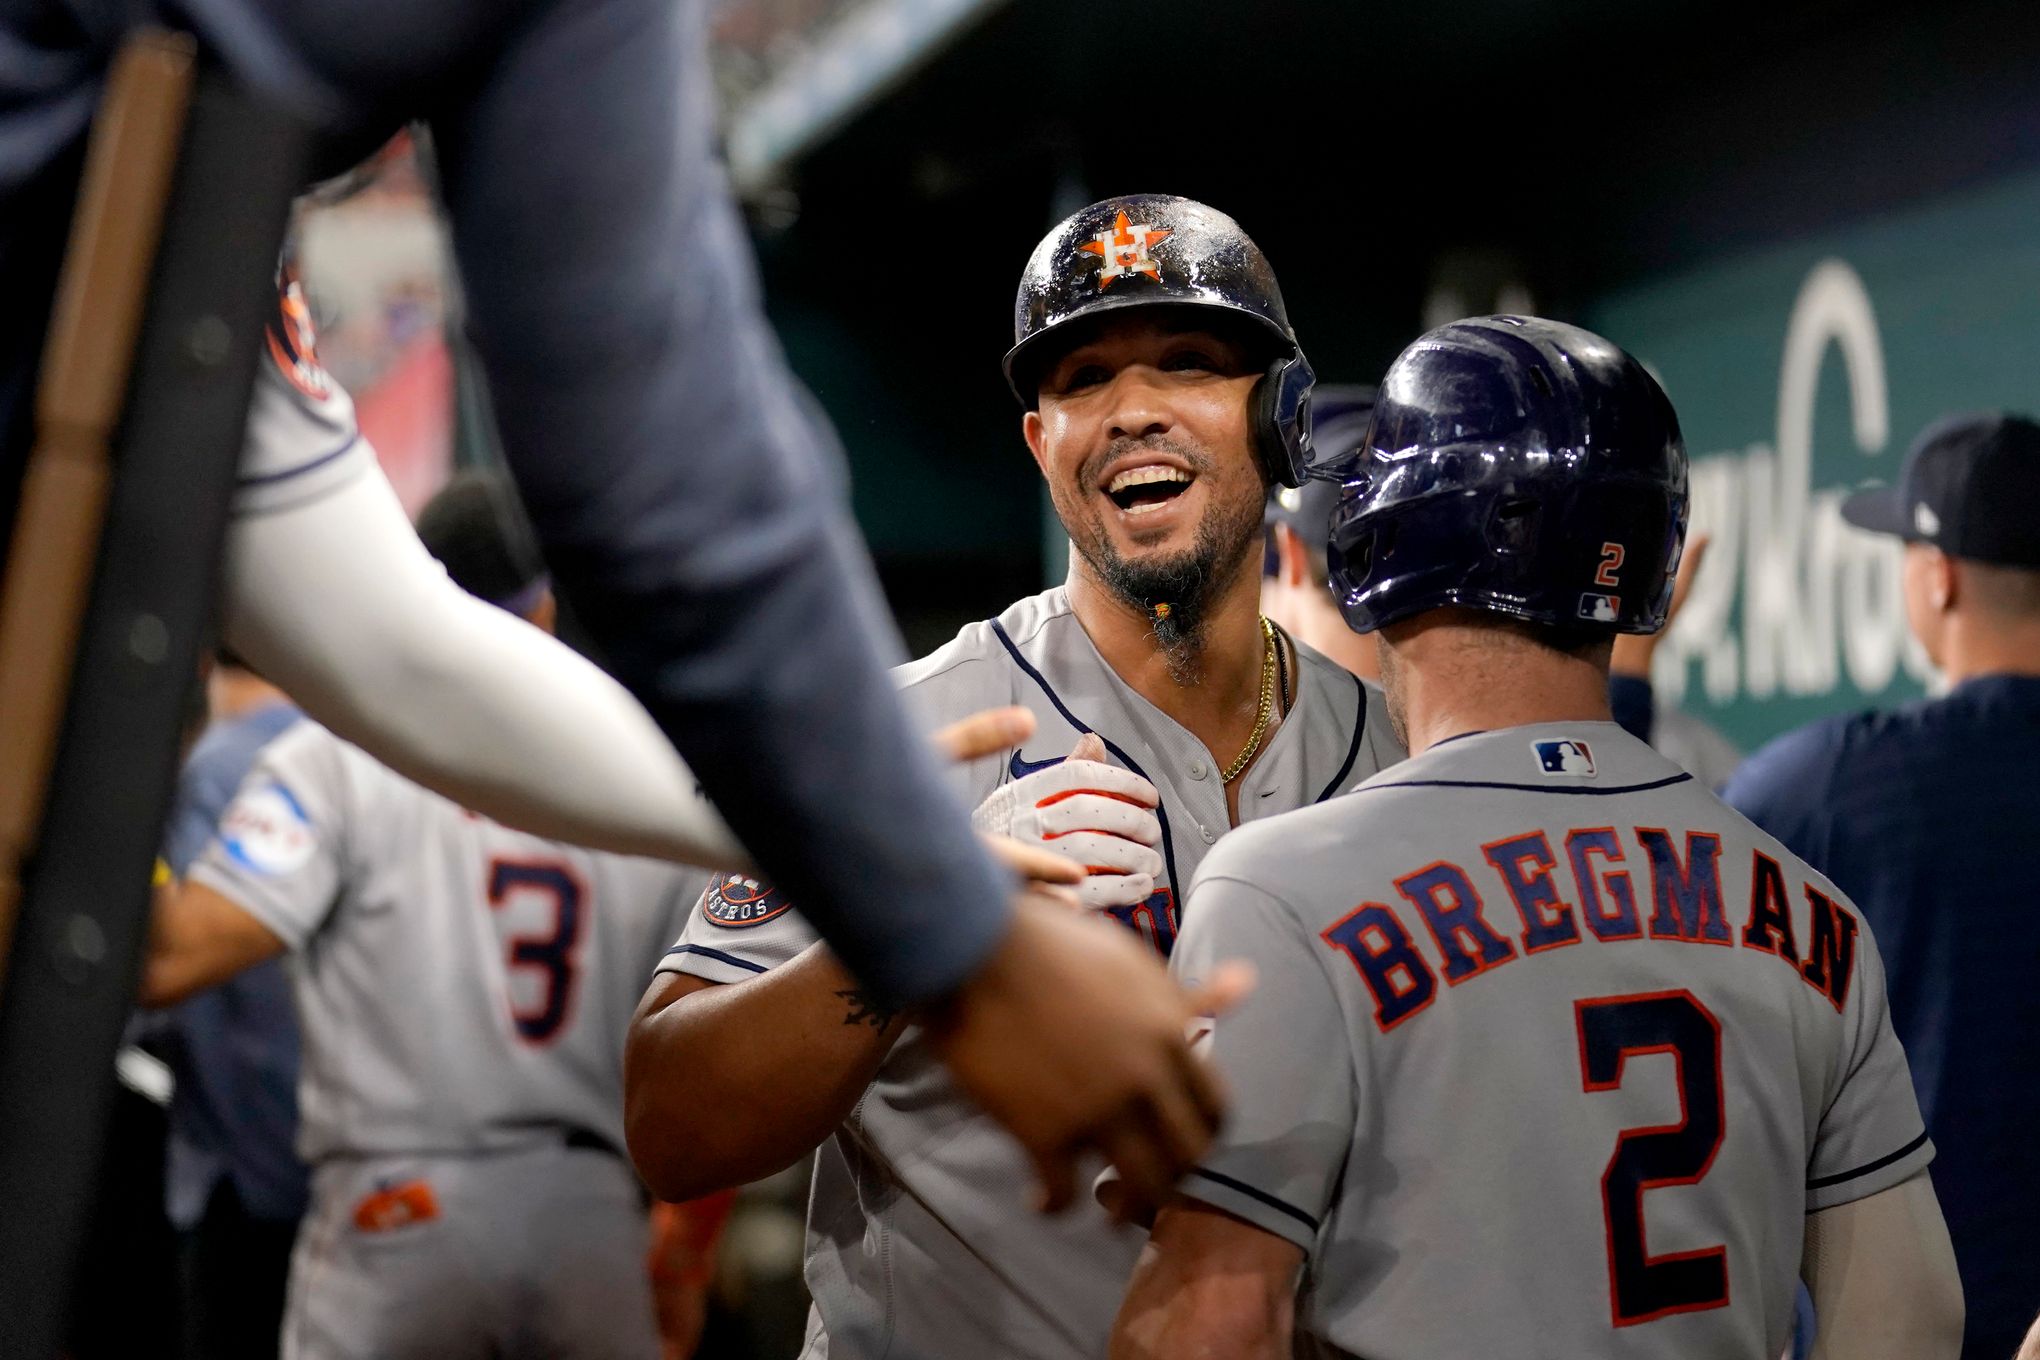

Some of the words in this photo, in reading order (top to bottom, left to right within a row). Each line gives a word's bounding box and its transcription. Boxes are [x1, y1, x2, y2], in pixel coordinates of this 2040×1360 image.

[1095, 224, 1157, 279] H
[1594, 542, 1625, 586] 2
[488, 855, 588, 1048] 3
[708, 887, 767, 920] ASTROS
[1320, 826, 1858, 1033] BREGMAN
[1574, 989, 1730, 1328] 2
